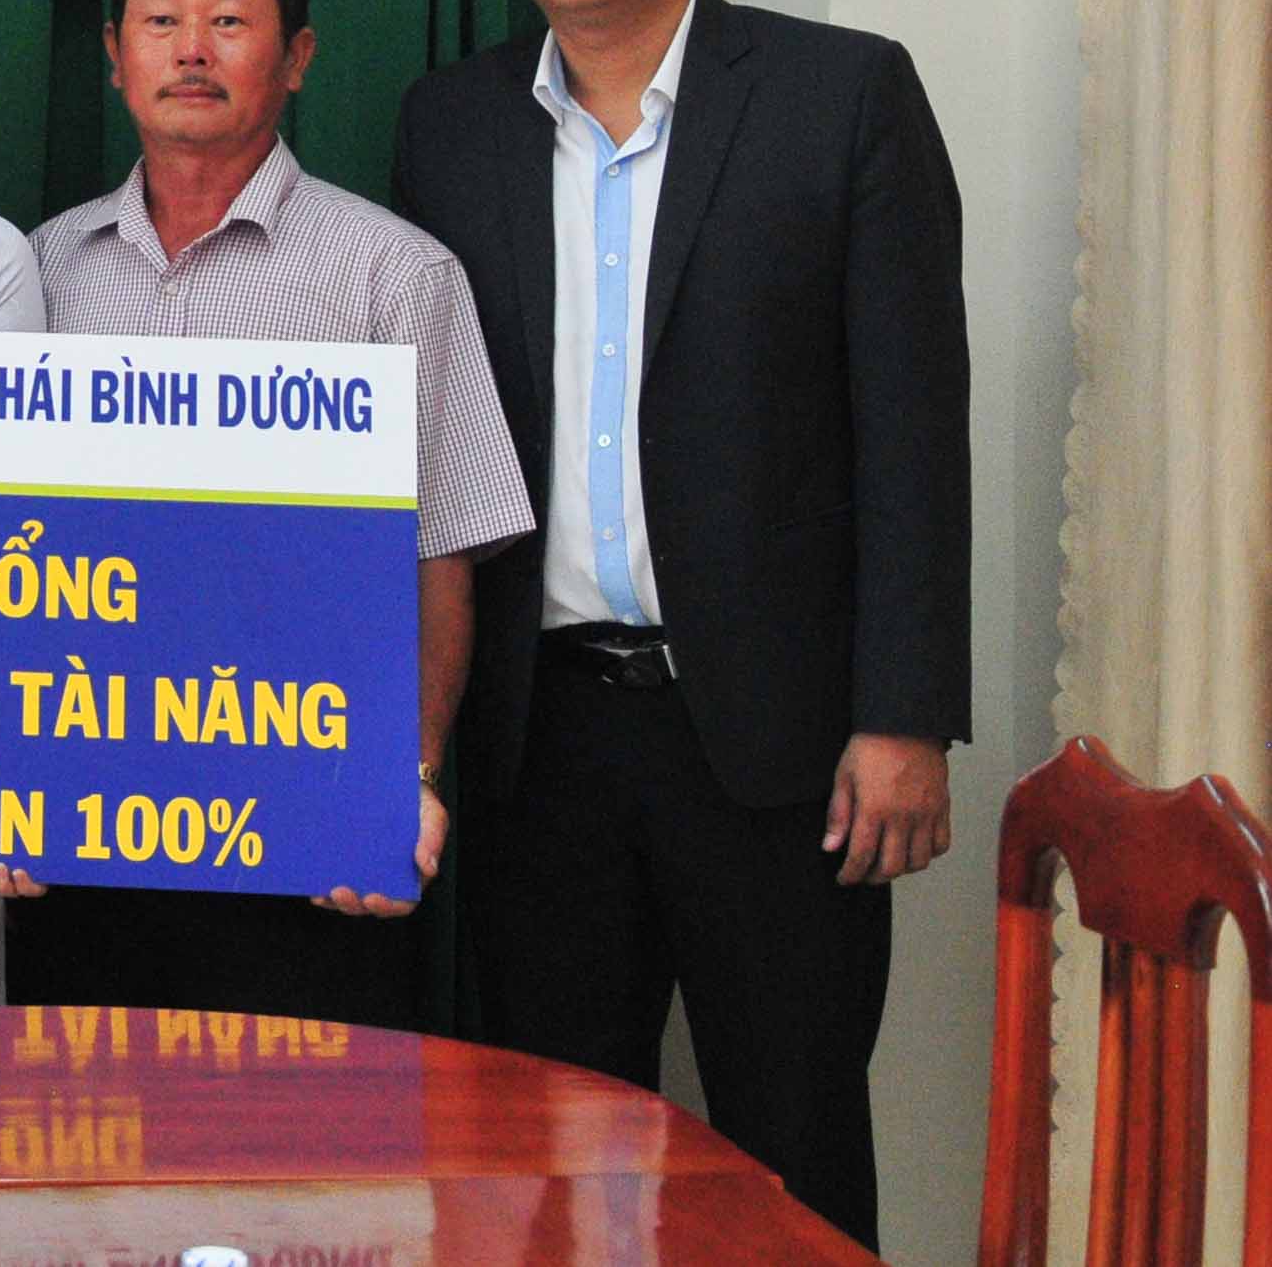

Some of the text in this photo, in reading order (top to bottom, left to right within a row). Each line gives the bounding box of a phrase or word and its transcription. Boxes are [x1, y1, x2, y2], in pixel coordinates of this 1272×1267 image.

[92, 357, 197, 426] BÌNH
[219, 365, 371, 432] DƯƠNG
[11, 655, 125, 739] TÀI
[155, 666, 347, 749] NĂNG
[77, 794, 263, 866] 100%
